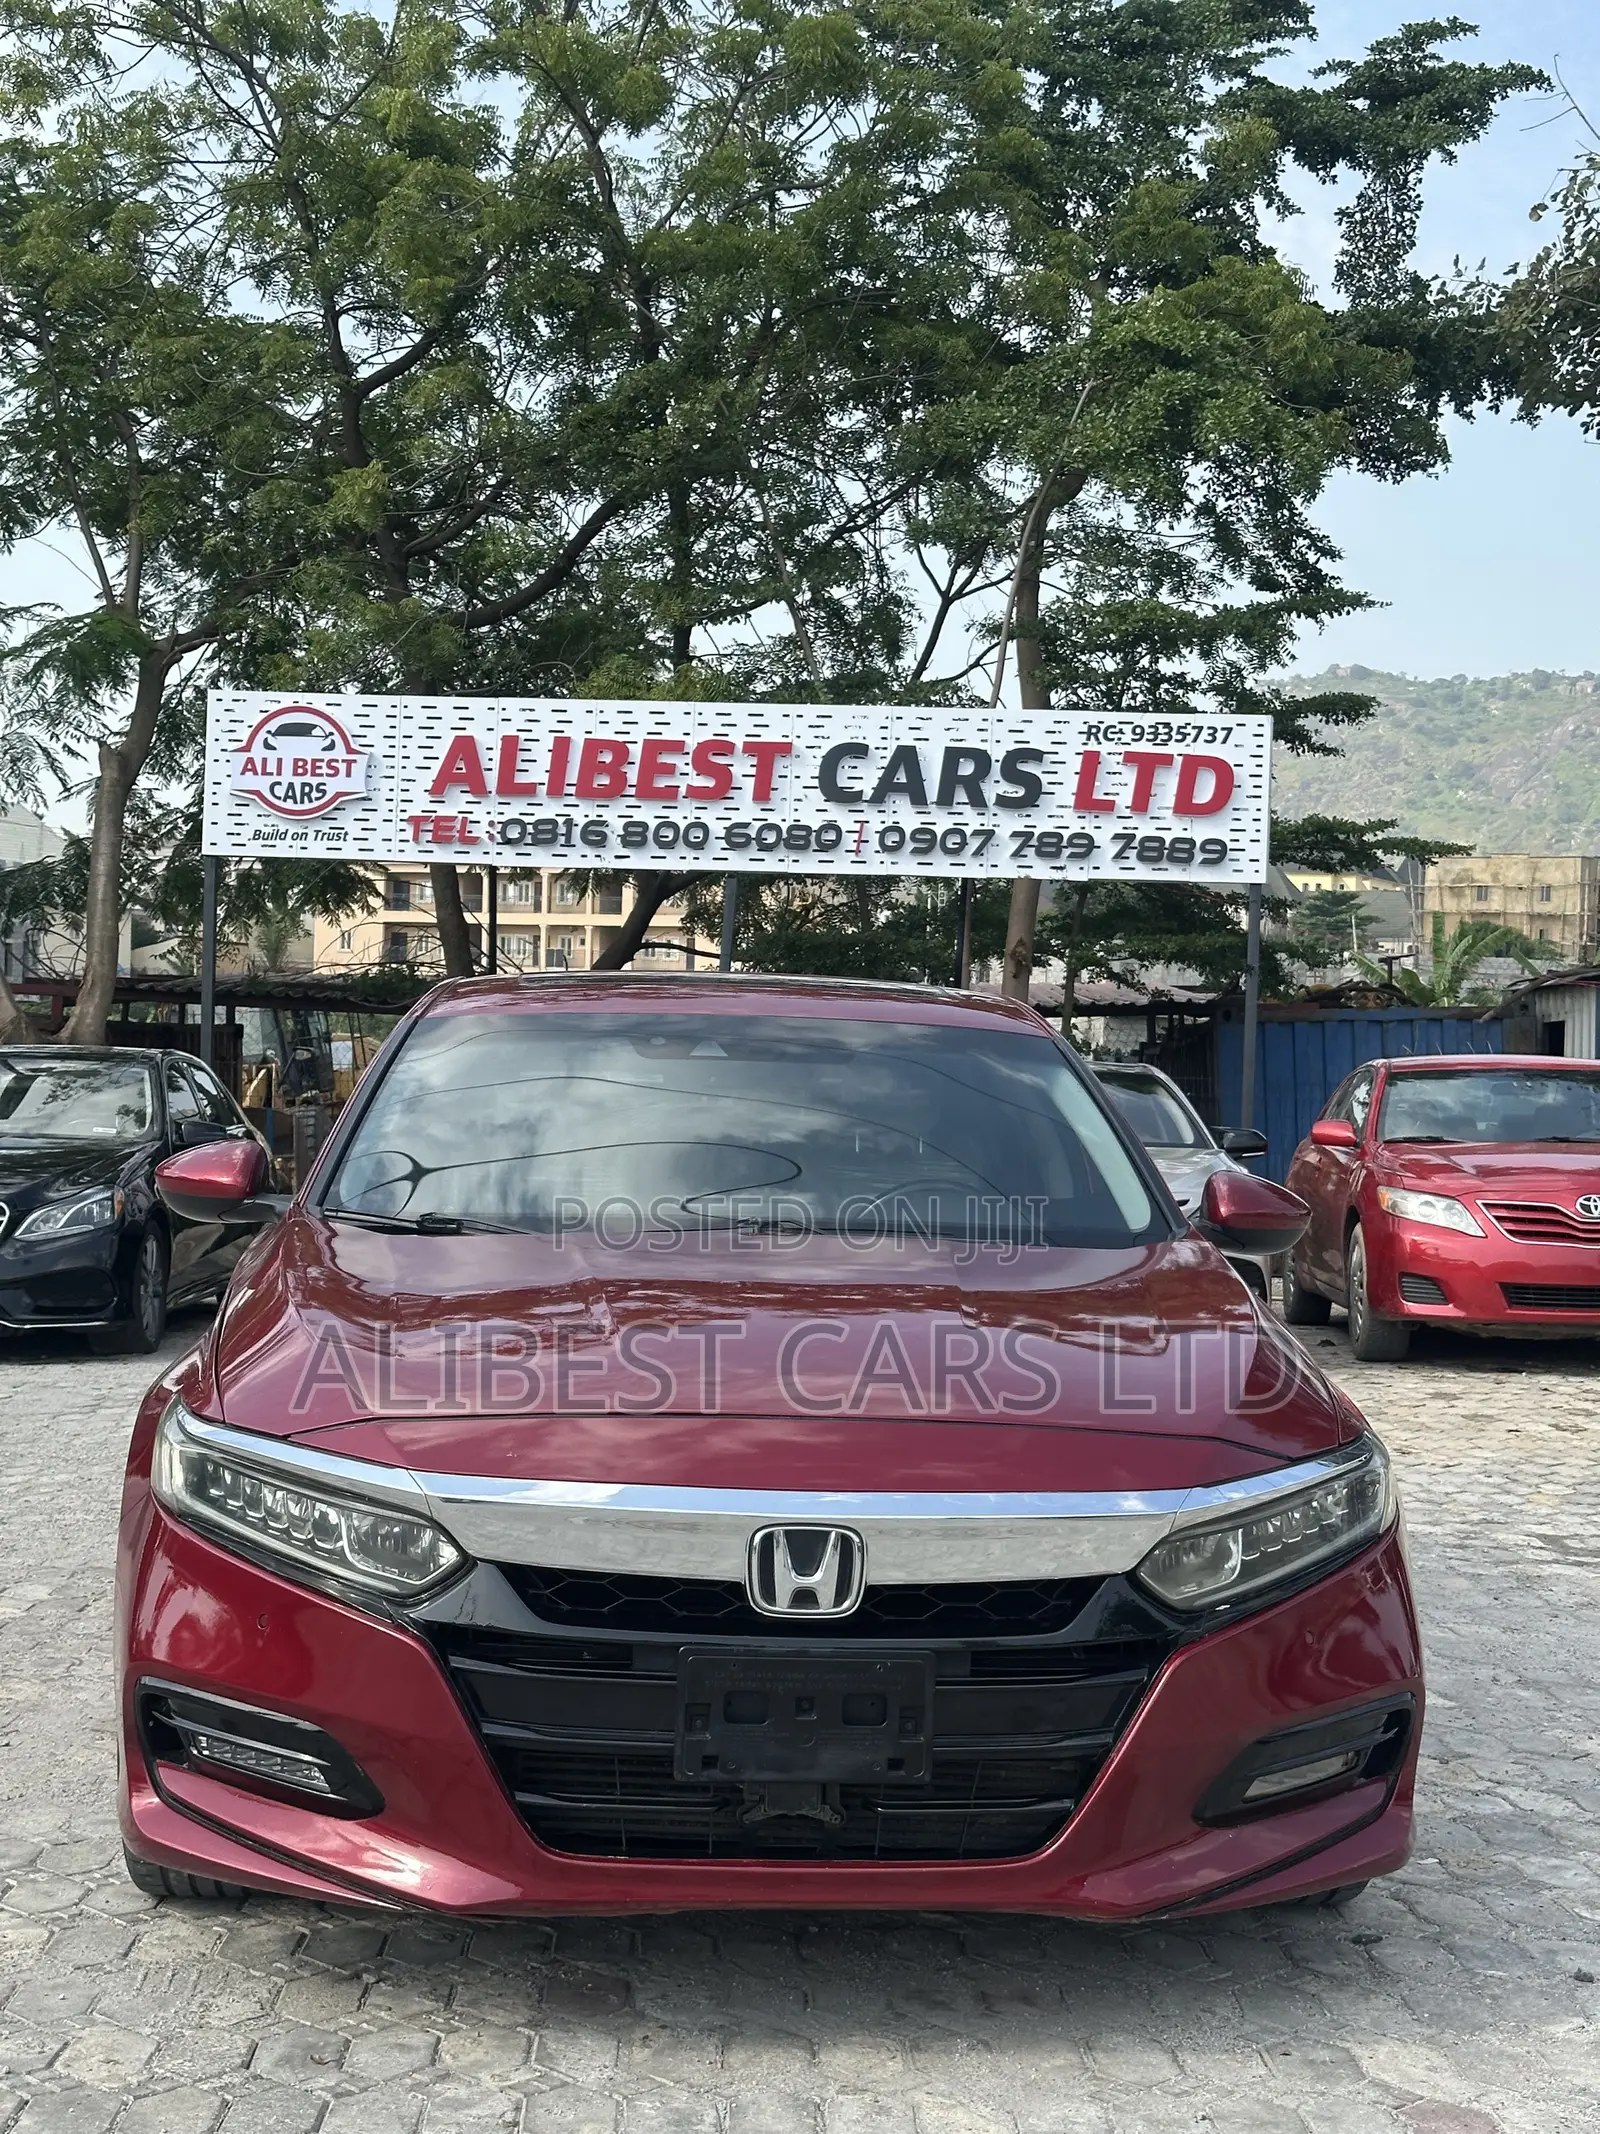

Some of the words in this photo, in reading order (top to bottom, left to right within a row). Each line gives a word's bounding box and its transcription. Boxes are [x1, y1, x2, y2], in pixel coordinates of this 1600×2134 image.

[1131, 725, 1234, 745] 9335737
[240, 757, 283, 777] ALI
[292, 758, 357, 778] BEST
[428, 734, 793, 804] ALIBEST
[817, 742, 1045, 811] CARS
[1073, 750, 1235, 818] LTD
[269, 781, 328, 805] CARS
[252, 829, 289, 842] Build
[291, 831, 308, 842] on
[313, 829, 349, 842] Trust
[499, 817, 609, 848] 0816
[620, 820, 710, 850] 800
[724, 821, 843, 851] 6080
[878, 825, 996, 857] 0907
[1009, 830, 1096, 861] 789
[1110, 833, 1229, 866] 7889
